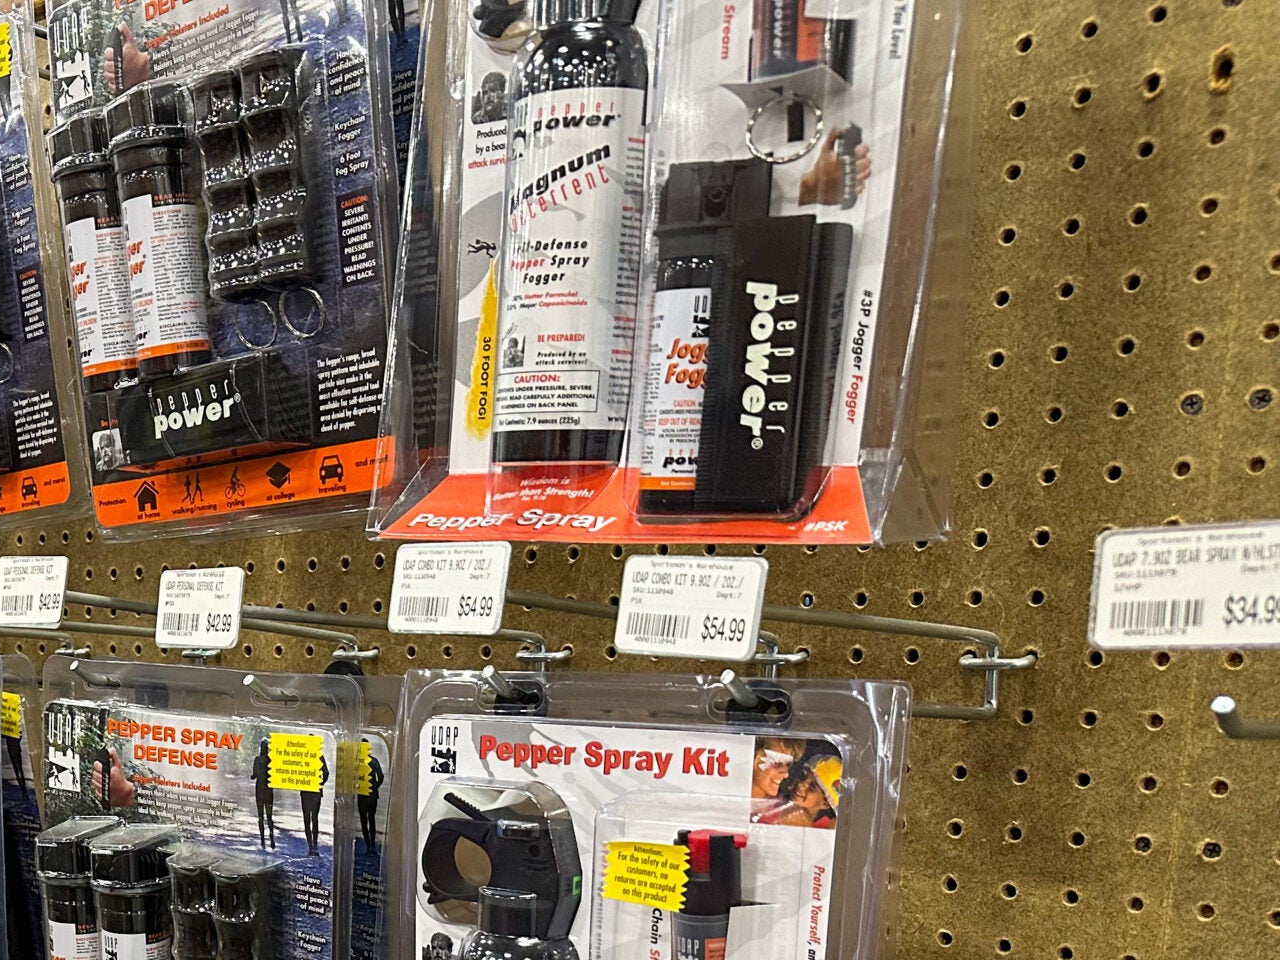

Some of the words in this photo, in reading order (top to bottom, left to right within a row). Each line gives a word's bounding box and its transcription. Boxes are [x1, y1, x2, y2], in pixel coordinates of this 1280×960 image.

[199, 4, 229, 26] Included
[721, 5, 735, 60] Stream
[329, 75, 342, 86] and
[344, 67, 364, 80] peace
[343, 79, 360, 92] mind
[335, 115, 365, 131] Keychain
[533, 113, 615, 134] power
[338, 128, 361, 142] Fogger
[346, 151, 360, 161] Foot
[336, 168, 348, 176] Fog
[349, 160, 369, 172] Spray
[345, 205, 364, 217] SEVERE
[342, 222, 372, 236] CONTENTS
[348, 233, 367, 244] UNDER
[351, 253, 366, 262] READ
[550, 255, 590, 268] Spray
[344, 259, 376, 274] WARNINGS
[523, 272, 565, 285] Fogger
[860, 290, 873, 317] #3P
[483, 337, 491, 352] 30
[853, 321, 870, 371] Jogger
[481, 355, 490, 388] FOOT
[766, 293, 799, 434] pepper
[514, 374, 560, 383] CAUTION:
[846, 374, 863, 425] Fogger
[544, 485, 595, 499] Strength!
[408, 512, 513, 531] Pepper
[516, 508, 617, 533] Spray
[803, 520, 849, 532] #PSK
[632, 571, 649, 583] UDAP
[651, 572, 671, 584] COMBO
[674, 573, 688, 585] KIT
[39, 593, 61, 610] $42.99
[458, 593, 493, 619] $54.99
[206, 612, 231, 634] $42.99
[701, 613, 745, 644] $54.99
[106, 718, 176, 743] PEPPER
[180, 729, 244, 752] SPRAY
[431, 725, 459, 746] UDAP
[133, 744, 218, 770] DEFENSE
[479, 735, 577, 769] Pepper
[583, 741, 673, 779] Spray
[682, 746, 730, 777] Kit
[182, 781, 211, 792] Included
[617, 851, 628, 861] For
[629, 854, 639, 864] the
[640, 856, 660, 869] safety
[661, 859, 669, 868] of
[626, 865, 659, 879] customers,
[660, 872, 668, 880] no
[296, 883, 329, 896] confidence
[614, 875, 636, 885] returns
[637, 878, 648, 886] are
[649, 878, 676, 894] accepted
[812, 864, 825, 901] Protect
[643, 890, 667, 903] product
[651, 908, 664, 945] Chain
[297, 930, 326, 944] Keychain
